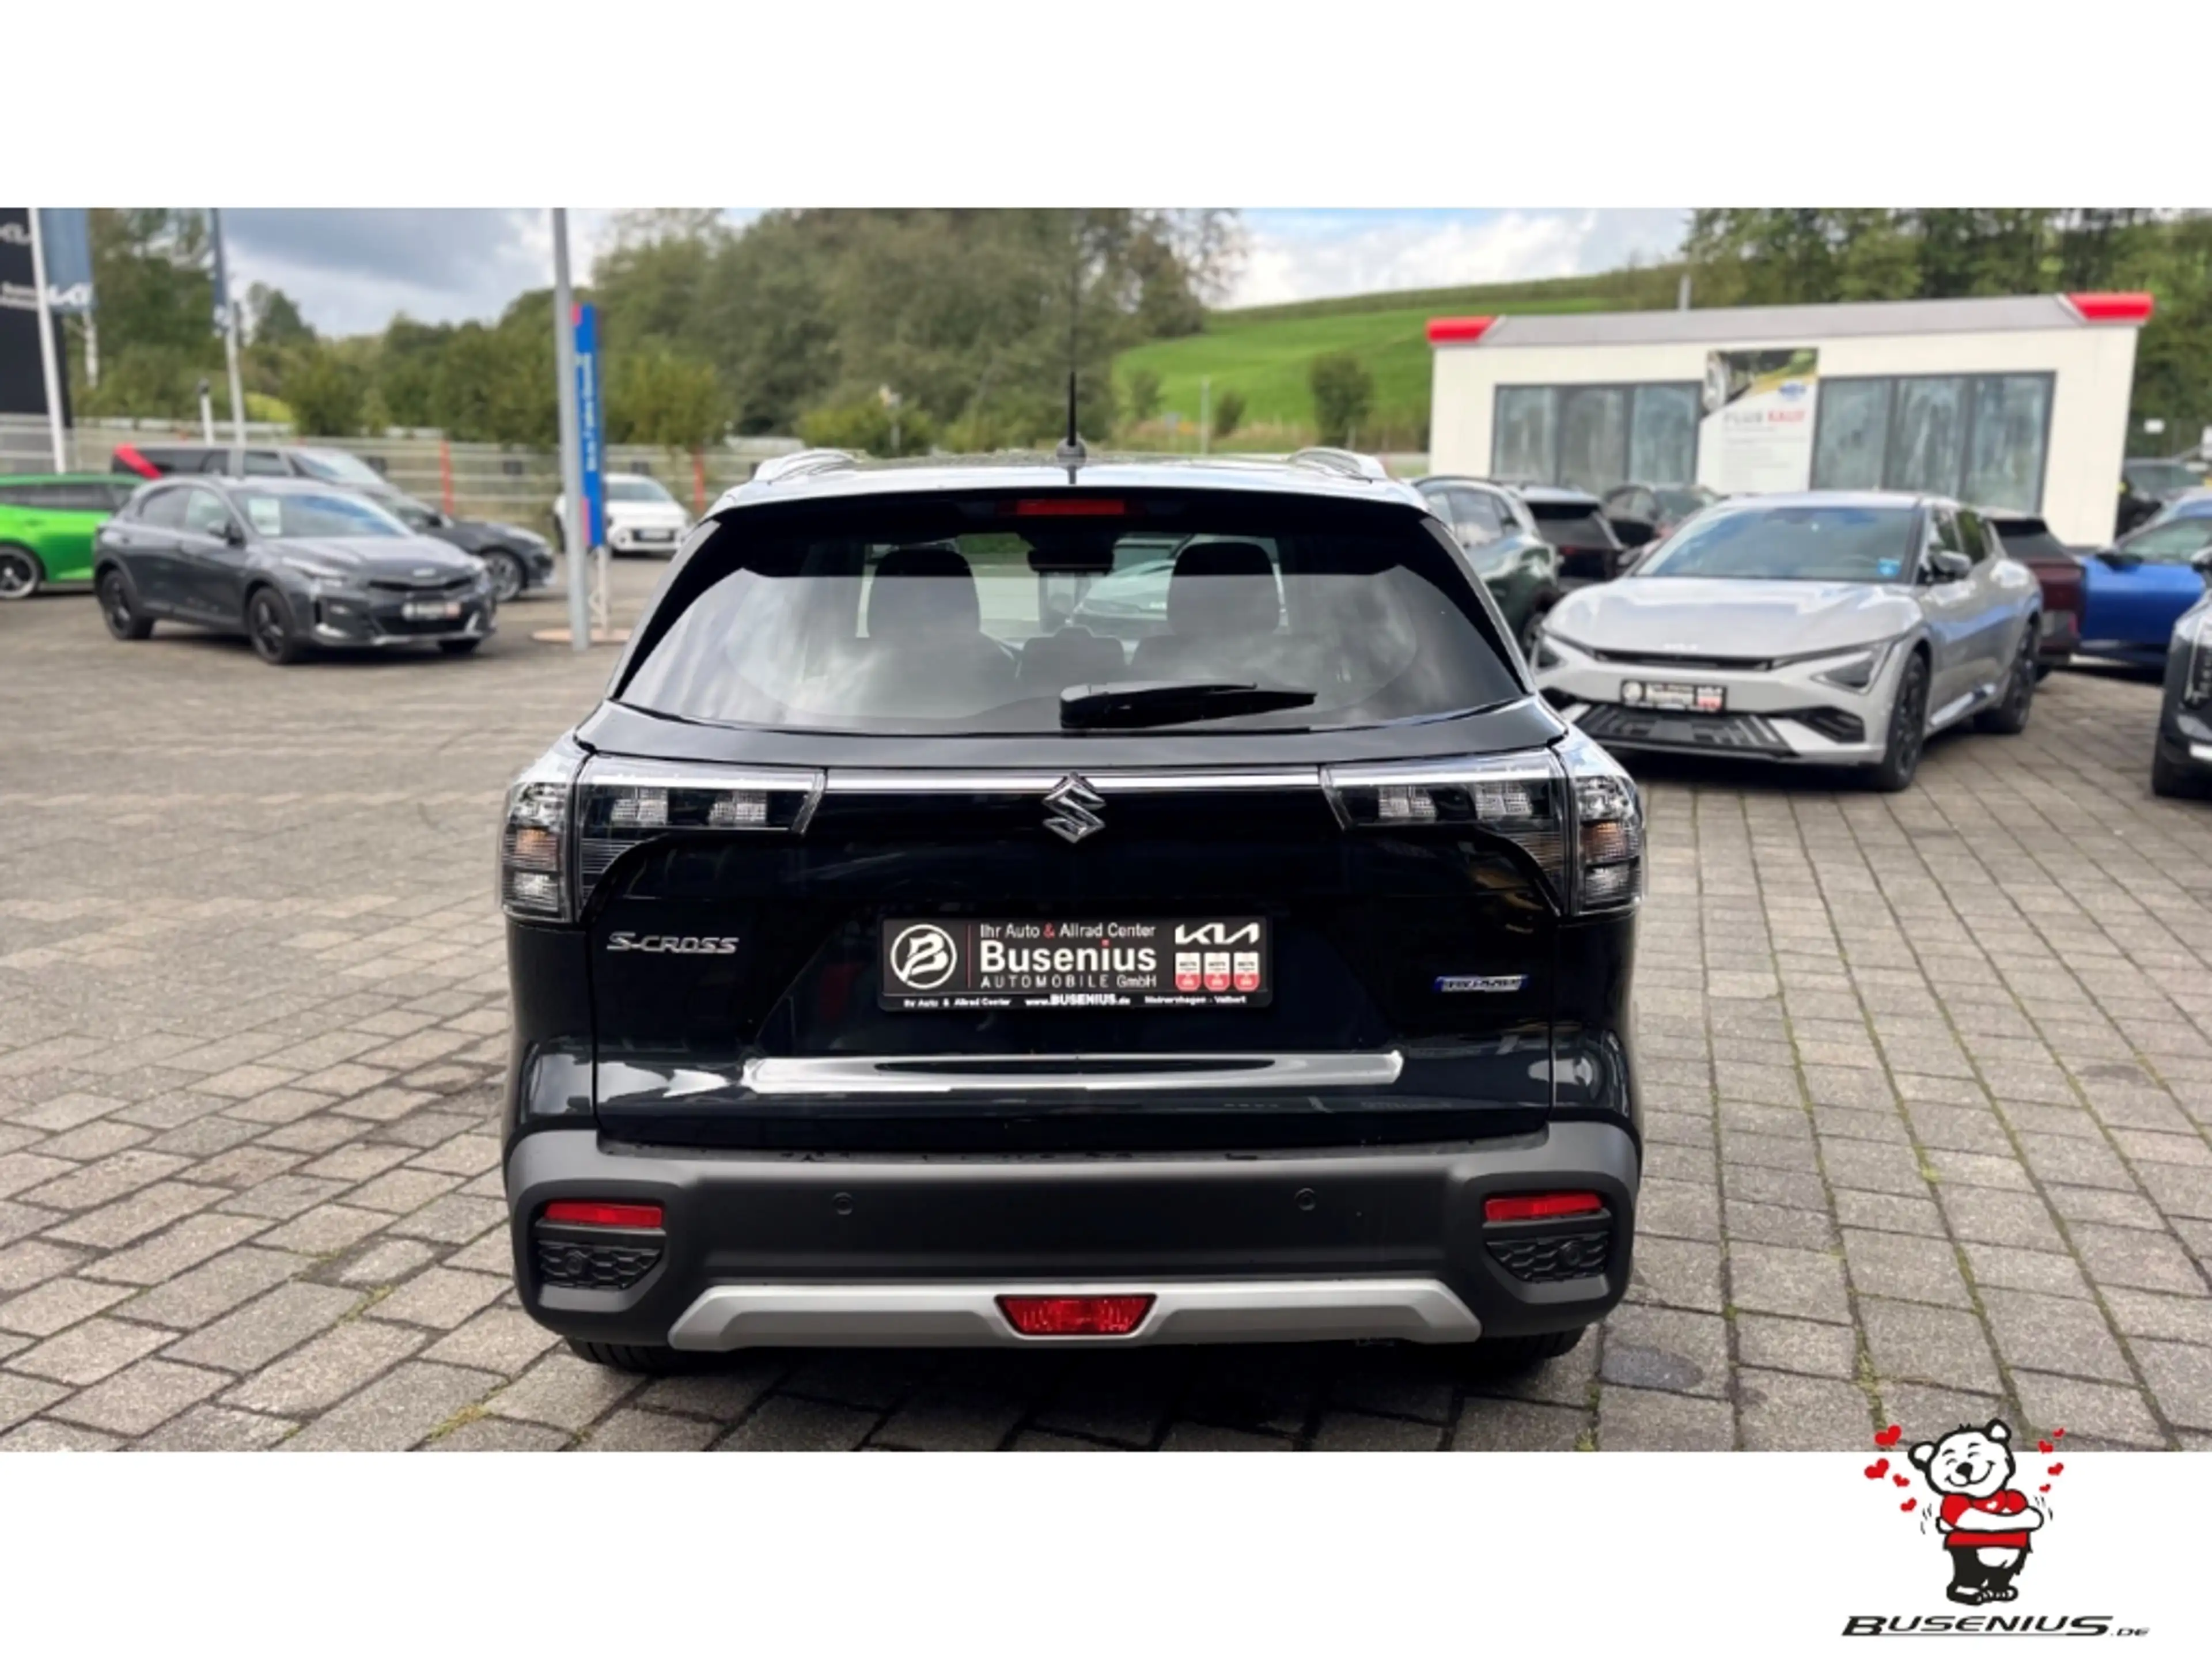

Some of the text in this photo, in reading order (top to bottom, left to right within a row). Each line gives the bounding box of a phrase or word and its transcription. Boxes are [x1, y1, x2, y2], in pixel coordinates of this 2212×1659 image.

[980, 923, 1156, 938] Ihr Auto & Allrad Center
[1175, 923, 1259, 945] KIA
[607, 931, 740, 954] S-CROSS
[980, 939, 1157, 973] Busenius
[980, 975, 1157, 988] AUTOMOBILE GmbH
